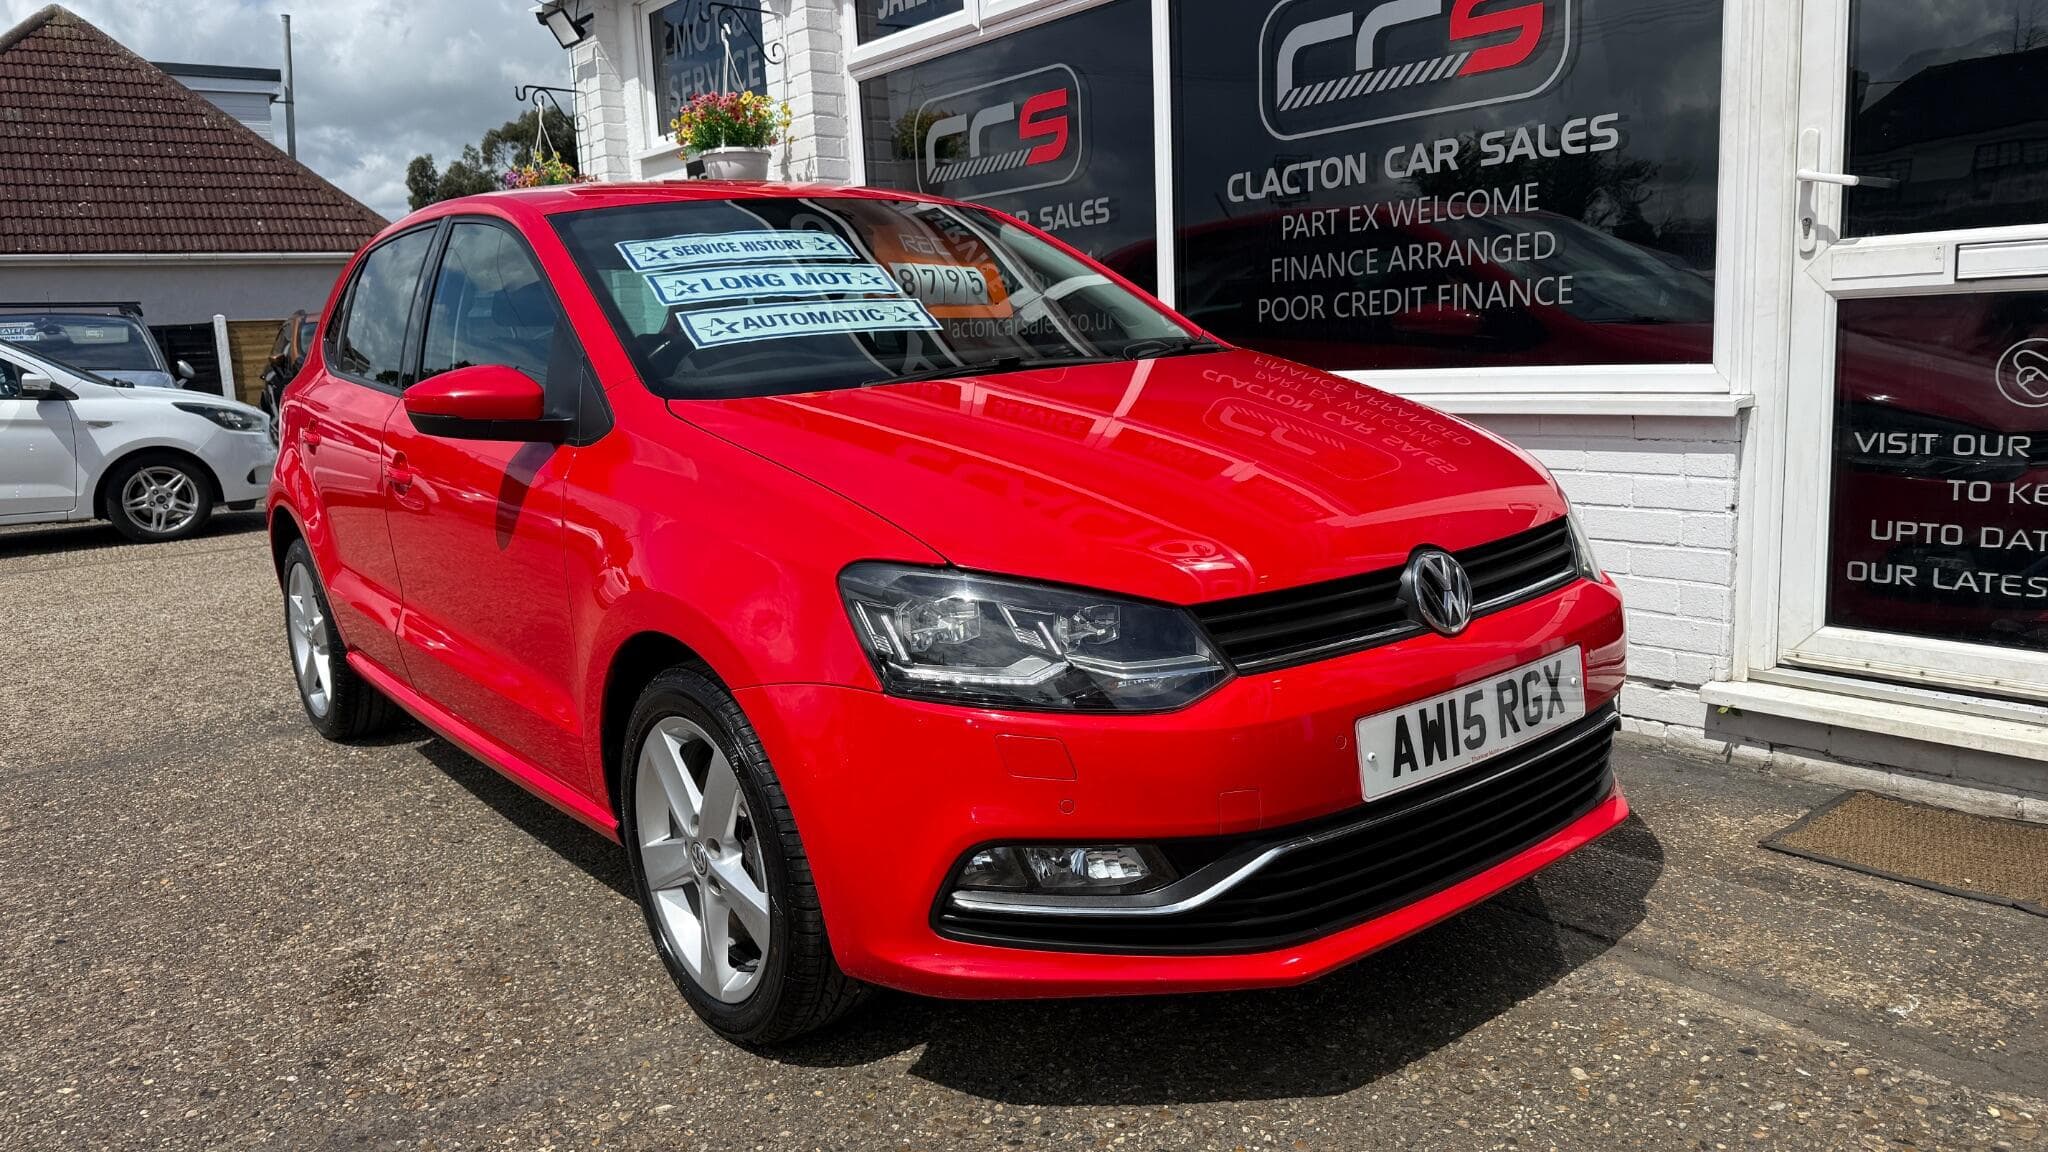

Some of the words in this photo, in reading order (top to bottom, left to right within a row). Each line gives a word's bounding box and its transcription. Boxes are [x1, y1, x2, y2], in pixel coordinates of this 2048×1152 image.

[669, 45, 761, 114] SERVCE
[1226, 152, 1367, 203] CLACTON
[1384, 137, 1460, 181] CAR
[1479, 113, 1620, 168] SALES
[1039, 196, 1110, 232] SALES
[1281, 208, 1340, 241] PART
[1349, 203, 1380, 233] EX
[1387, 182, 1540, 229] WELCOME
[671, 242, 742, 257] SERVICE
[744, 238, 805, 253] HISTORY
[1271, 248, 1379, 283] FINANCE
[1387, 230, 1557, 273] ARRANGED
[700, 273, 782, 292] LONG
[791, 271, 853, 287] MOT
[899, 268, 984, 296] 8795
[1258, 295, 1326, 323] POOR
[1333, 286, 1428, 318] CREDIT
[1438, 276, 1574, 313] FINANCE
[742, 307, 886, 331] AUTOMATIC
[1854, 431, 1939, 454] VISIT
[1953, 434, 2032, 458] OUR
[1946, 479, 1992, 502] TO
[2008, 482, 2048, 505] KE
[1871, 519, 1963, 546] UPTO
[1980, 526, 2048, 552] DAT
[1847, 560, 1918, 587] OUR
[1933, 567, 2048, 598] LATES
[1392, 689, 1487, 779] AW15
[1496, 659, 1566, 740] RGX
